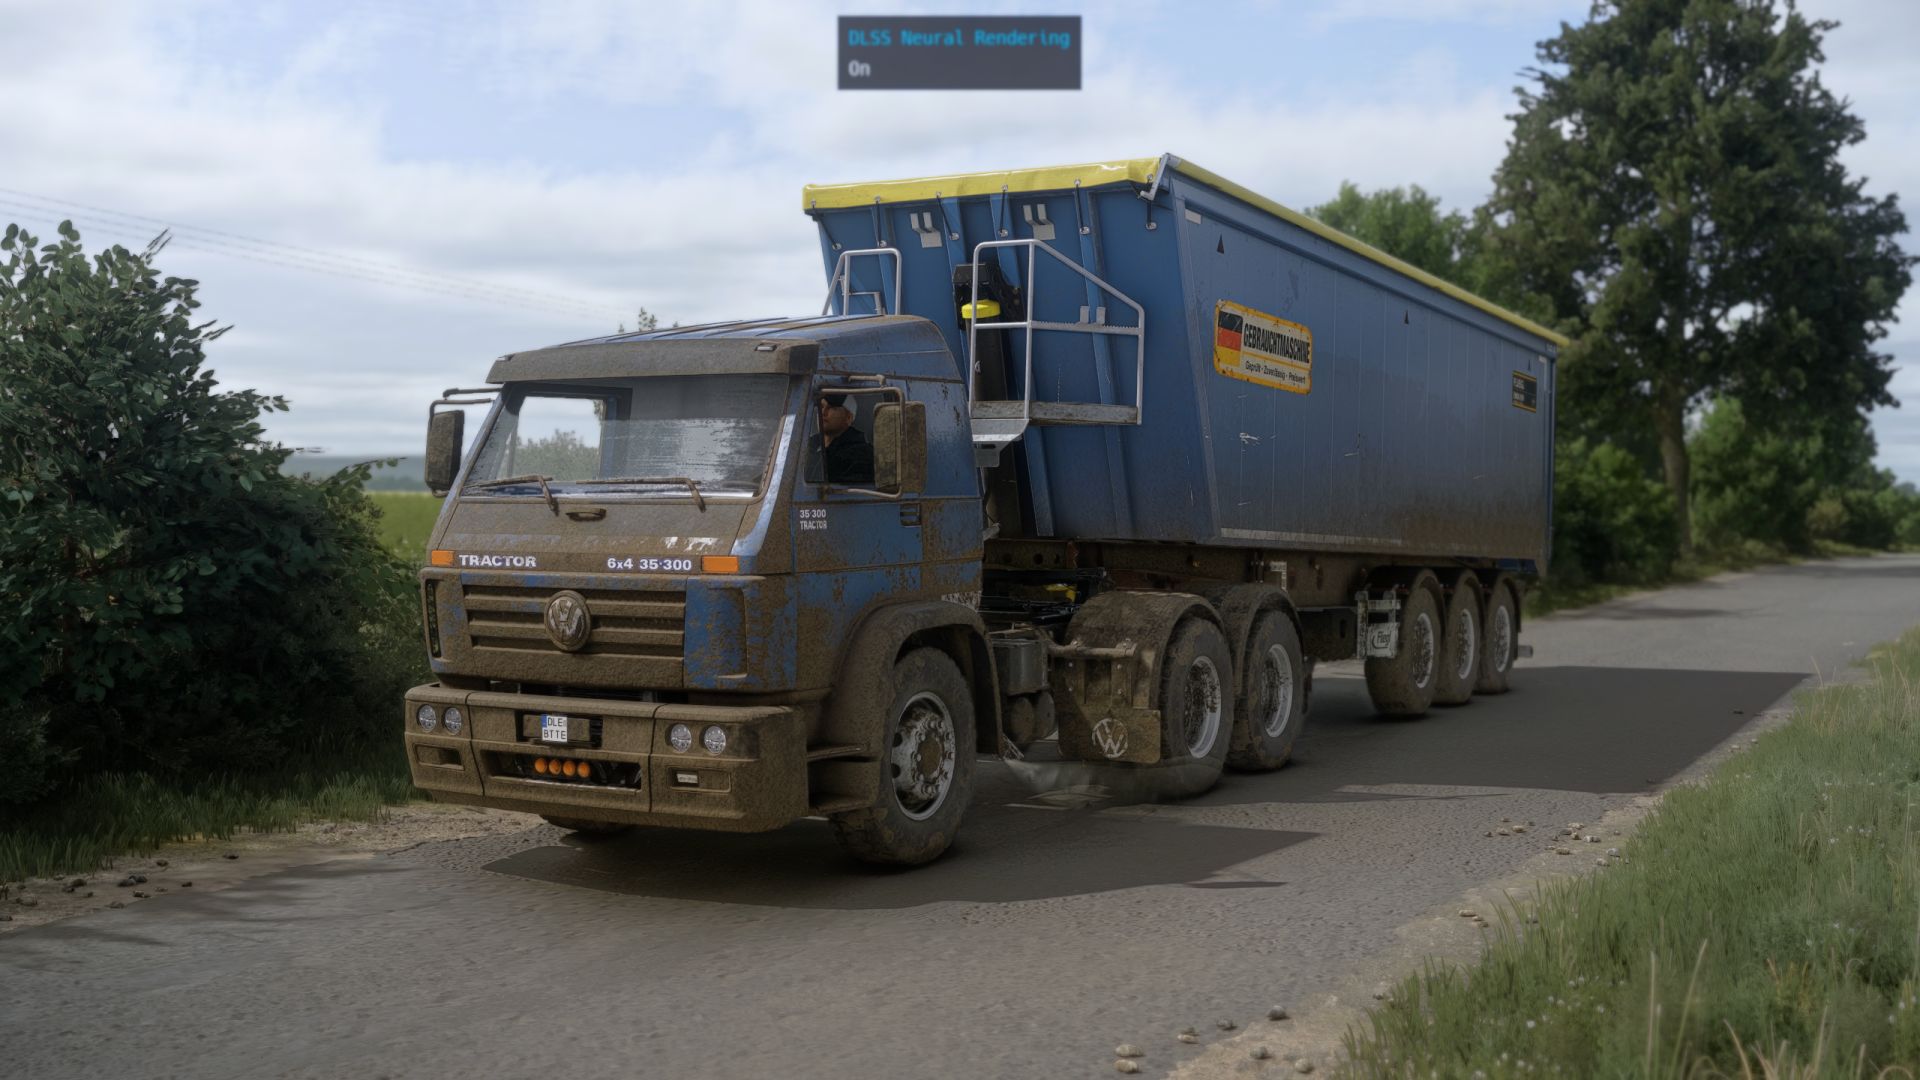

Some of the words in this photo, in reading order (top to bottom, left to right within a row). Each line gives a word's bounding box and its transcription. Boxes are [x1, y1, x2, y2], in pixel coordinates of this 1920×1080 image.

[1243, 322, 1310, 363] GEBRAUCHTMASCHINE
[800, 520, 828, 530] TRACTOR
[458, 554, 537, 567] TRACTOR
[607, 557, 634, 569] 6x4
[547, 717, 563, 727] DLE
[543, 729, 567, 740] BTTE
